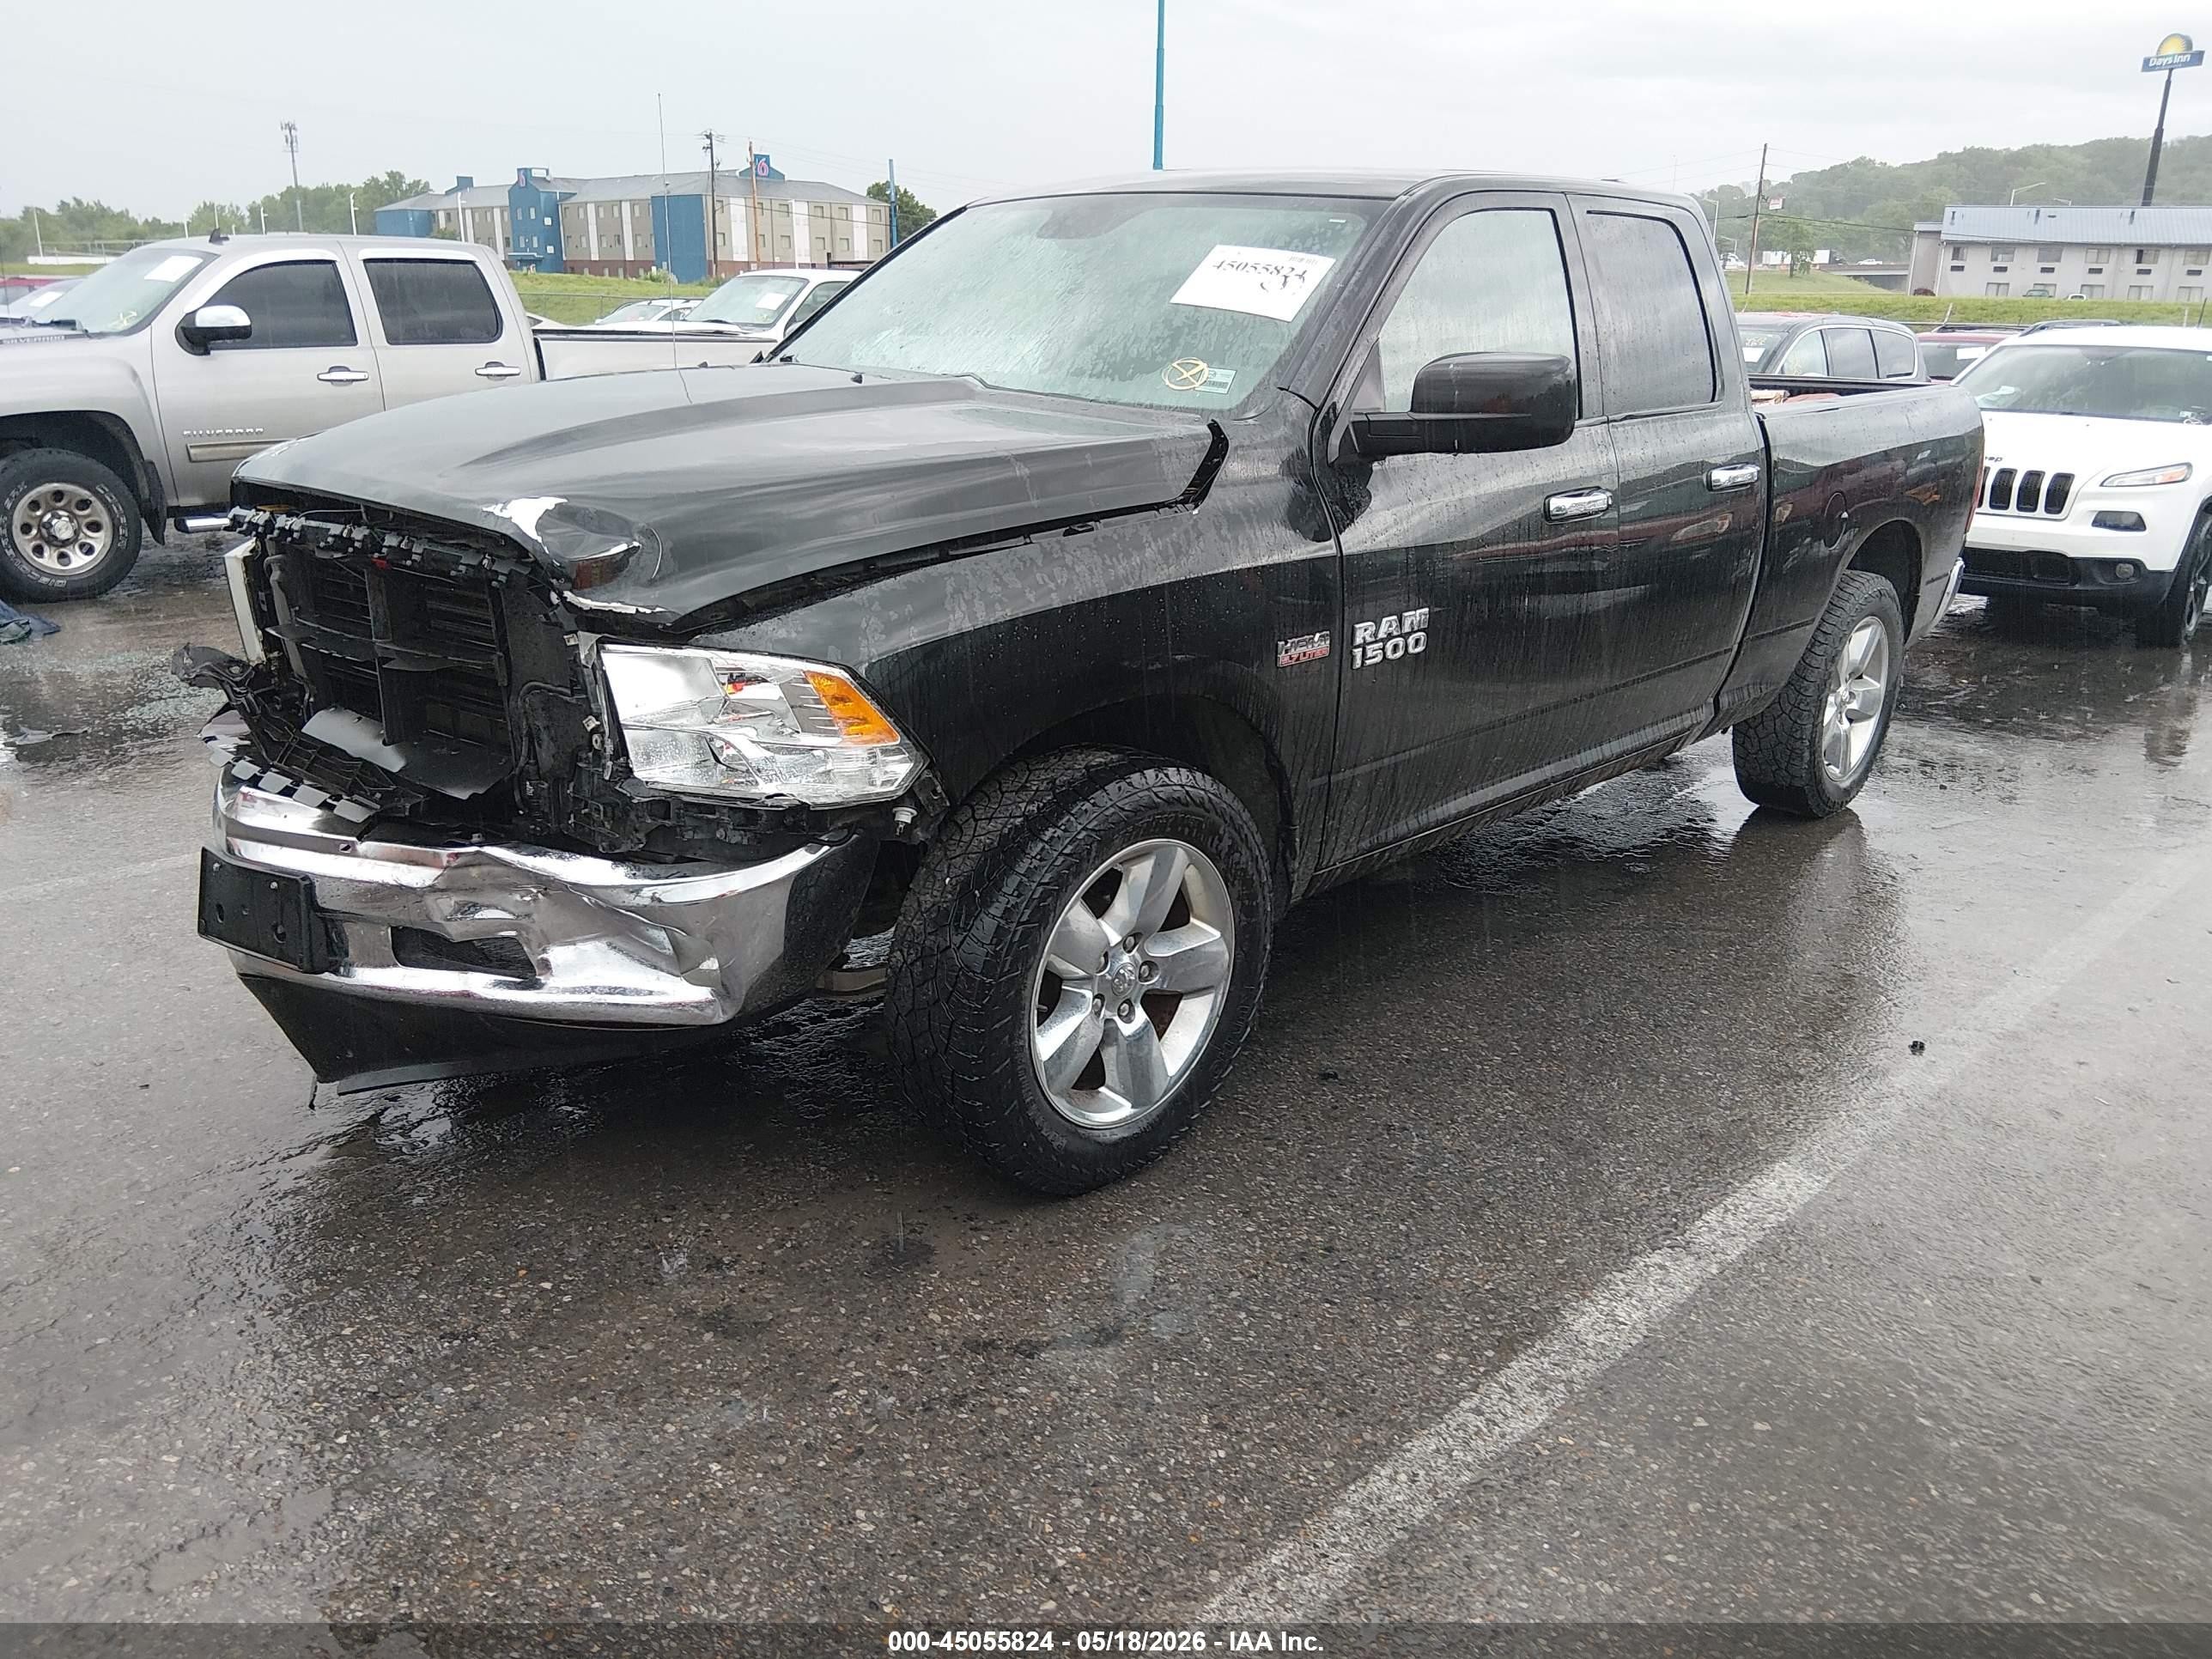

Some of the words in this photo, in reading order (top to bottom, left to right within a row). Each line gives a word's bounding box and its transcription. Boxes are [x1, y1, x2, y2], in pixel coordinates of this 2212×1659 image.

[2148, 57, 2173, 67] Days
[2173, 54, 2191, 64] Inn
[1352, 607, 1430, 647] RAM
[1351, 631, 1428, 670] 1500
